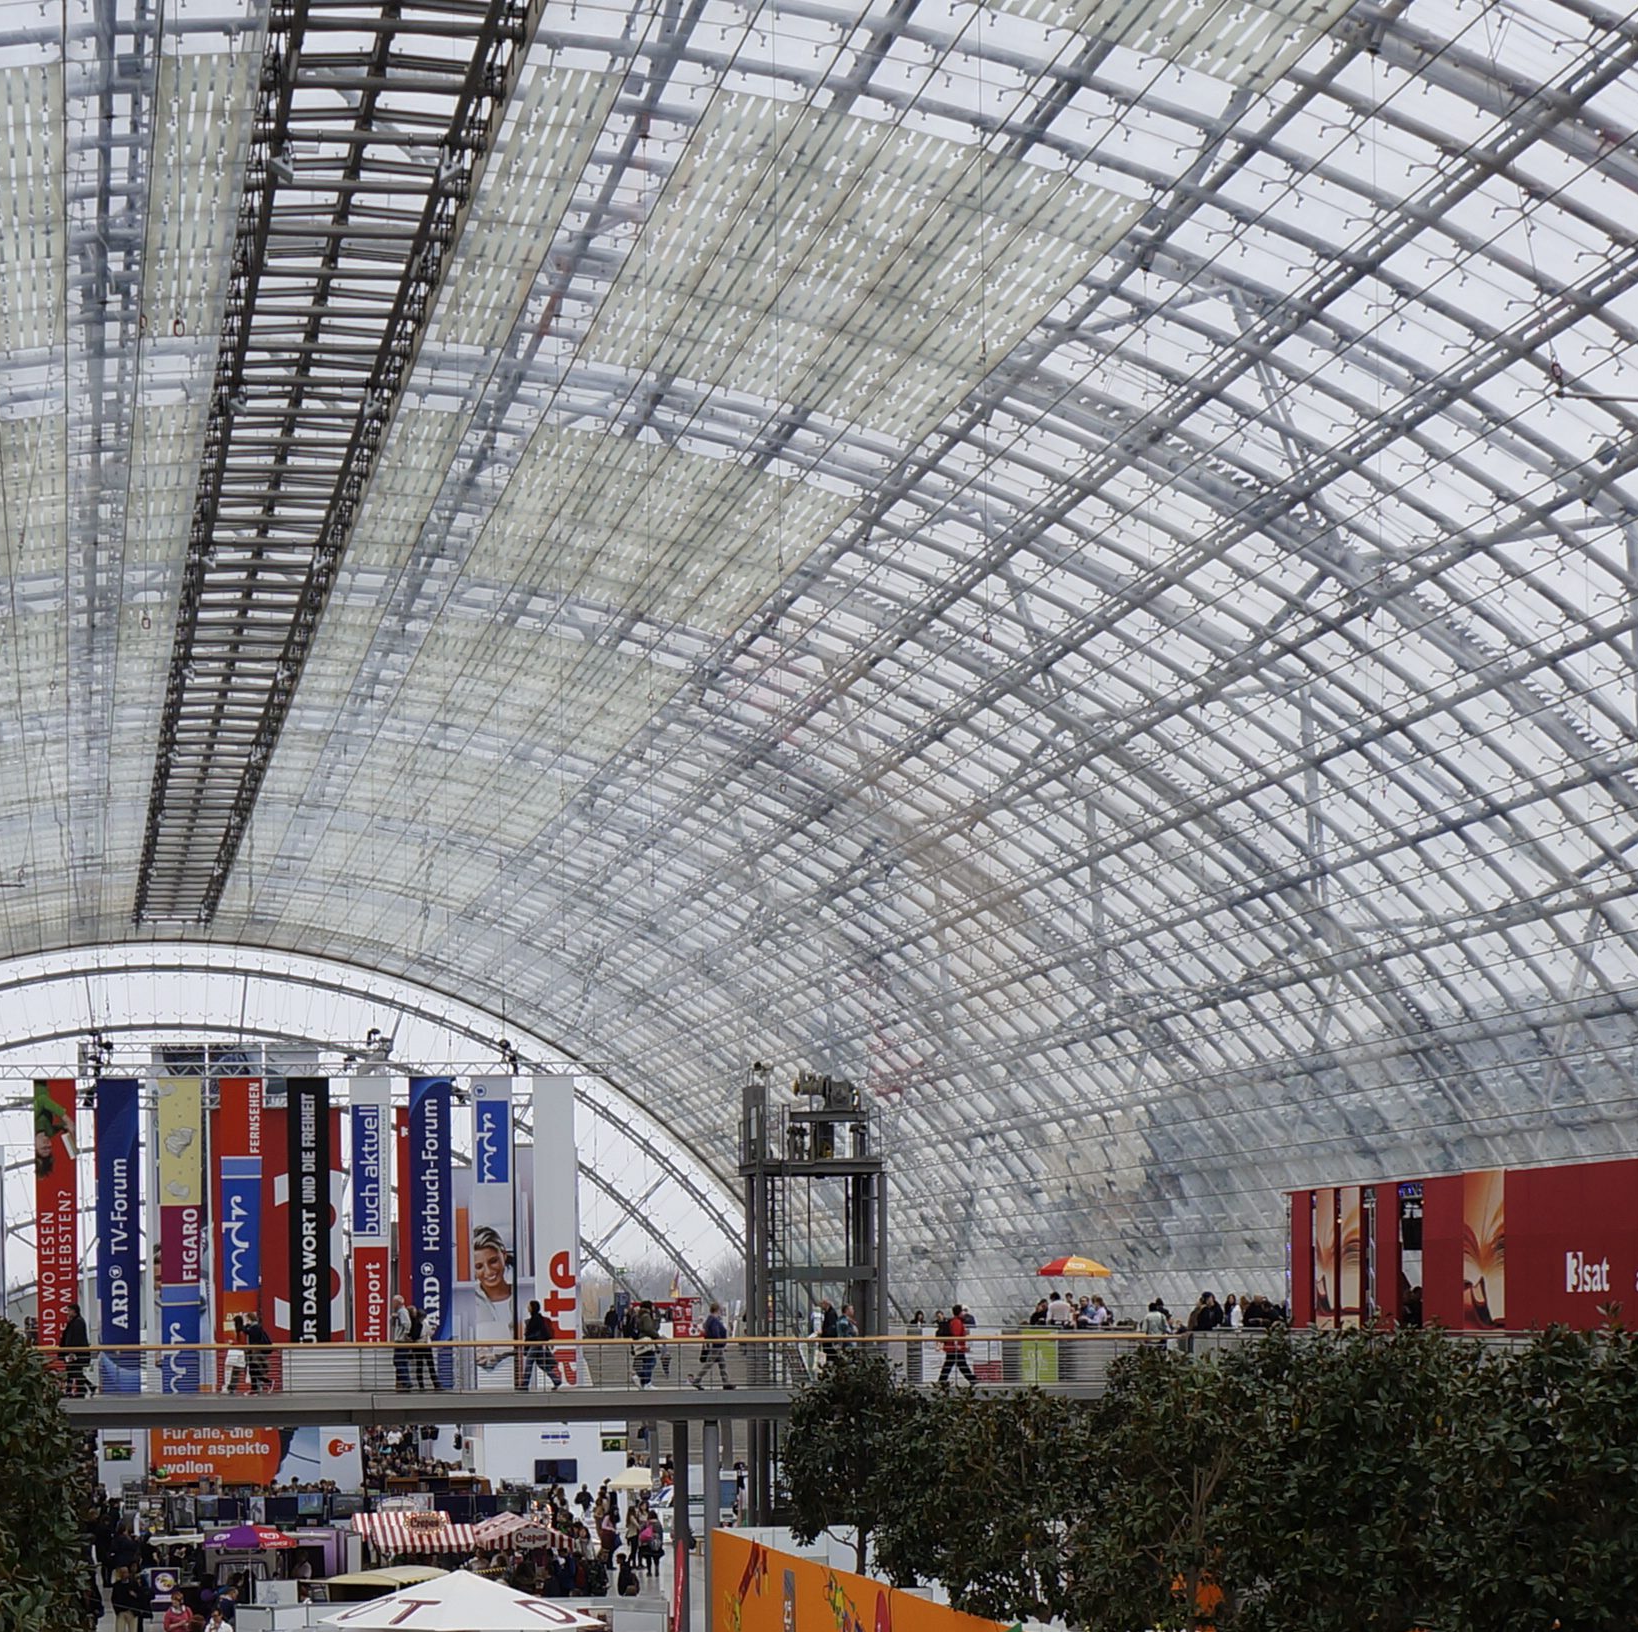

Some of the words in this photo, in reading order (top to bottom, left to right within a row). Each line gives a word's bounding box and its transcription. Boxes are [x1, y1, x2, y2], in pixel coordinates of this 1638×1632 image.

[248, 1082, 261, 1154] FERNSEHEN
[300, 1092, 316, 1148] FREIHEIT
[360, 1105, 379, 1178] aktuell
[301, 1149, 316, 1170] DIE
[421, 1098, 440, 1252] Hörbuch-Forum
[111, 1157, 128, 1256] TV-Forum
[301, 1173, 316, 1204] UND
[360, 1184, 379, 1236] buch
[40, 1212, 56, 1265] LESEN
[58, 1190, 73, 1284] LIEBSTEN?
[182, 1208, 199, 1282] FIGARO
[301, 1208, 317, 1270] WORT
[42, 1273, 57, 1304] WO
[112, 1281, 129, 1330] ARD
[302, 1273, 317, 1315] DAS
[423, 1277, 441, 1326] ARD
[544, 1250, 577, 1387] arte
[162, 1443, 202, 1456] mehr
[207, 1443, 270, 1458] aspekte
[164, 1460, 214, 1474] wollen
